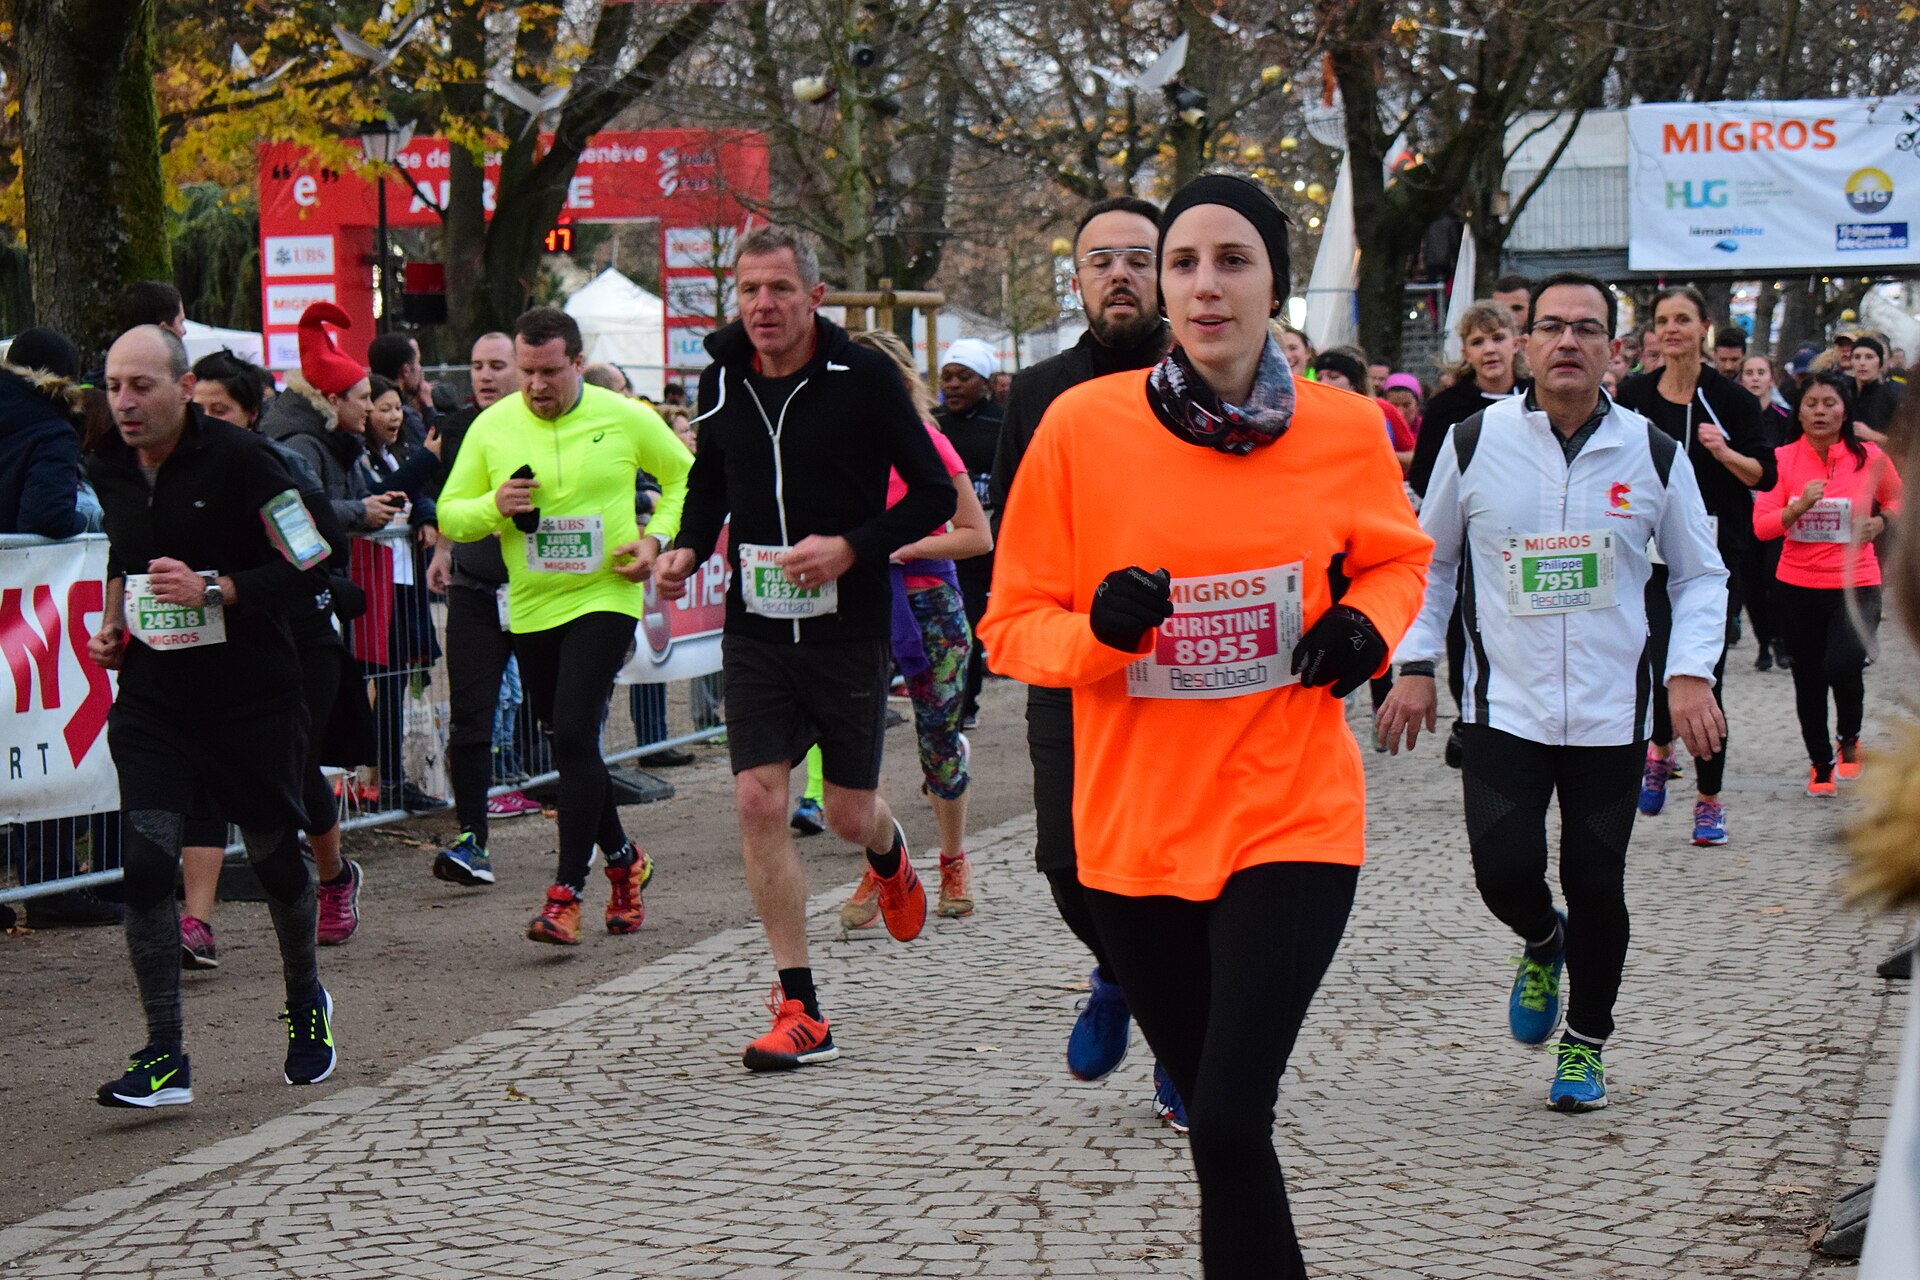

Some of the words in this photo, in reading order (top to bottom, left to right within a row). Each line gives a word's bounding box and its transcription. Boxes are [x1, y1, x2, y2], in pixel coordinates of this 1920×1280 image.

[1662, 118, 1837, 154] MIGROS
[578, 142, 648, 163] enève
[1665, 179, 1728, 209] HUG
[1853, 190, 1888, 203] SIG
[294, 247, 325, 263] UBS
[557, 519, 585, 531] UBS
[546, 535, 582, 545] XAVIER
[1524, 535, 1592, 551] MIGROS
[541, 545, 588, 557] 36934
[543, 561, 587, 570] MIGROS
[1537, 559, 1583, 572] Philippe
[1167, 576, 1266, 604] MIGROS
[1534, 572, 1584, 592] 7951
[1531, 591, 1591, 609] Aeschbach
[143, 610, 200, 629] 24518
[1160, 607, 1271, 637] CHRISTINE
[148, 632, 200, 646] MIGROS
[1175, 633, 1260, 665] 8955
[1170, 662, 1268, 690] Aeschbach
